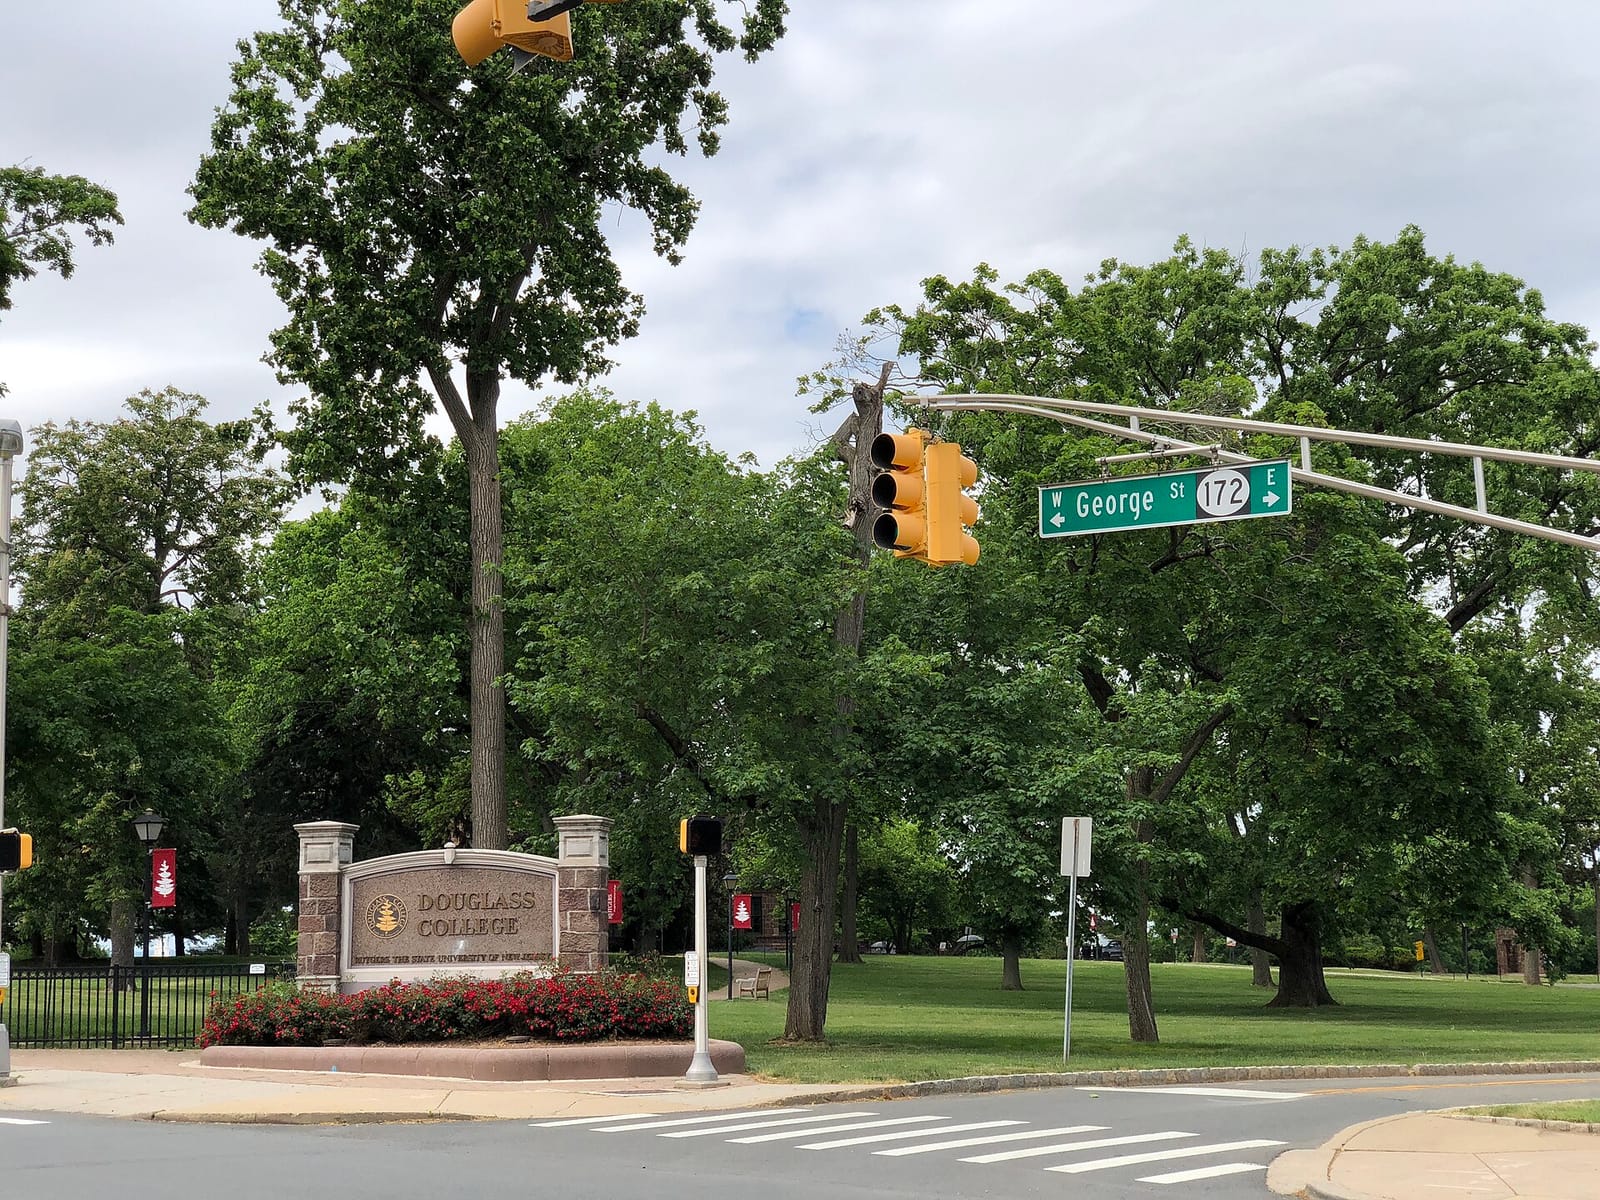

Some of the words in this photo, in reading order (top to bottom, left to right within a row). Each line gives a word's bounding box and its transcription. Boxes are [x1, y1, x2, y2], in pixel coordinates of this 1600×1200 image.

[1051, 491, 1063, 508] W
[1076, 490, 1154, 521] George
[1170, 481, 1185, 499] St
[1204, 477, 1244, 507] 172
[1266, 468, 1276, 486] E
[418, 892, 535, 910] DOUGLASS
[418, 917, 519, 937] COLLEGE
[392, 955, 409, 963] THE
[411, 954, 435, 963] STATE
[438, 954, 486, 962] UNIVERSITY
[489, 953, 499, 961] OF
